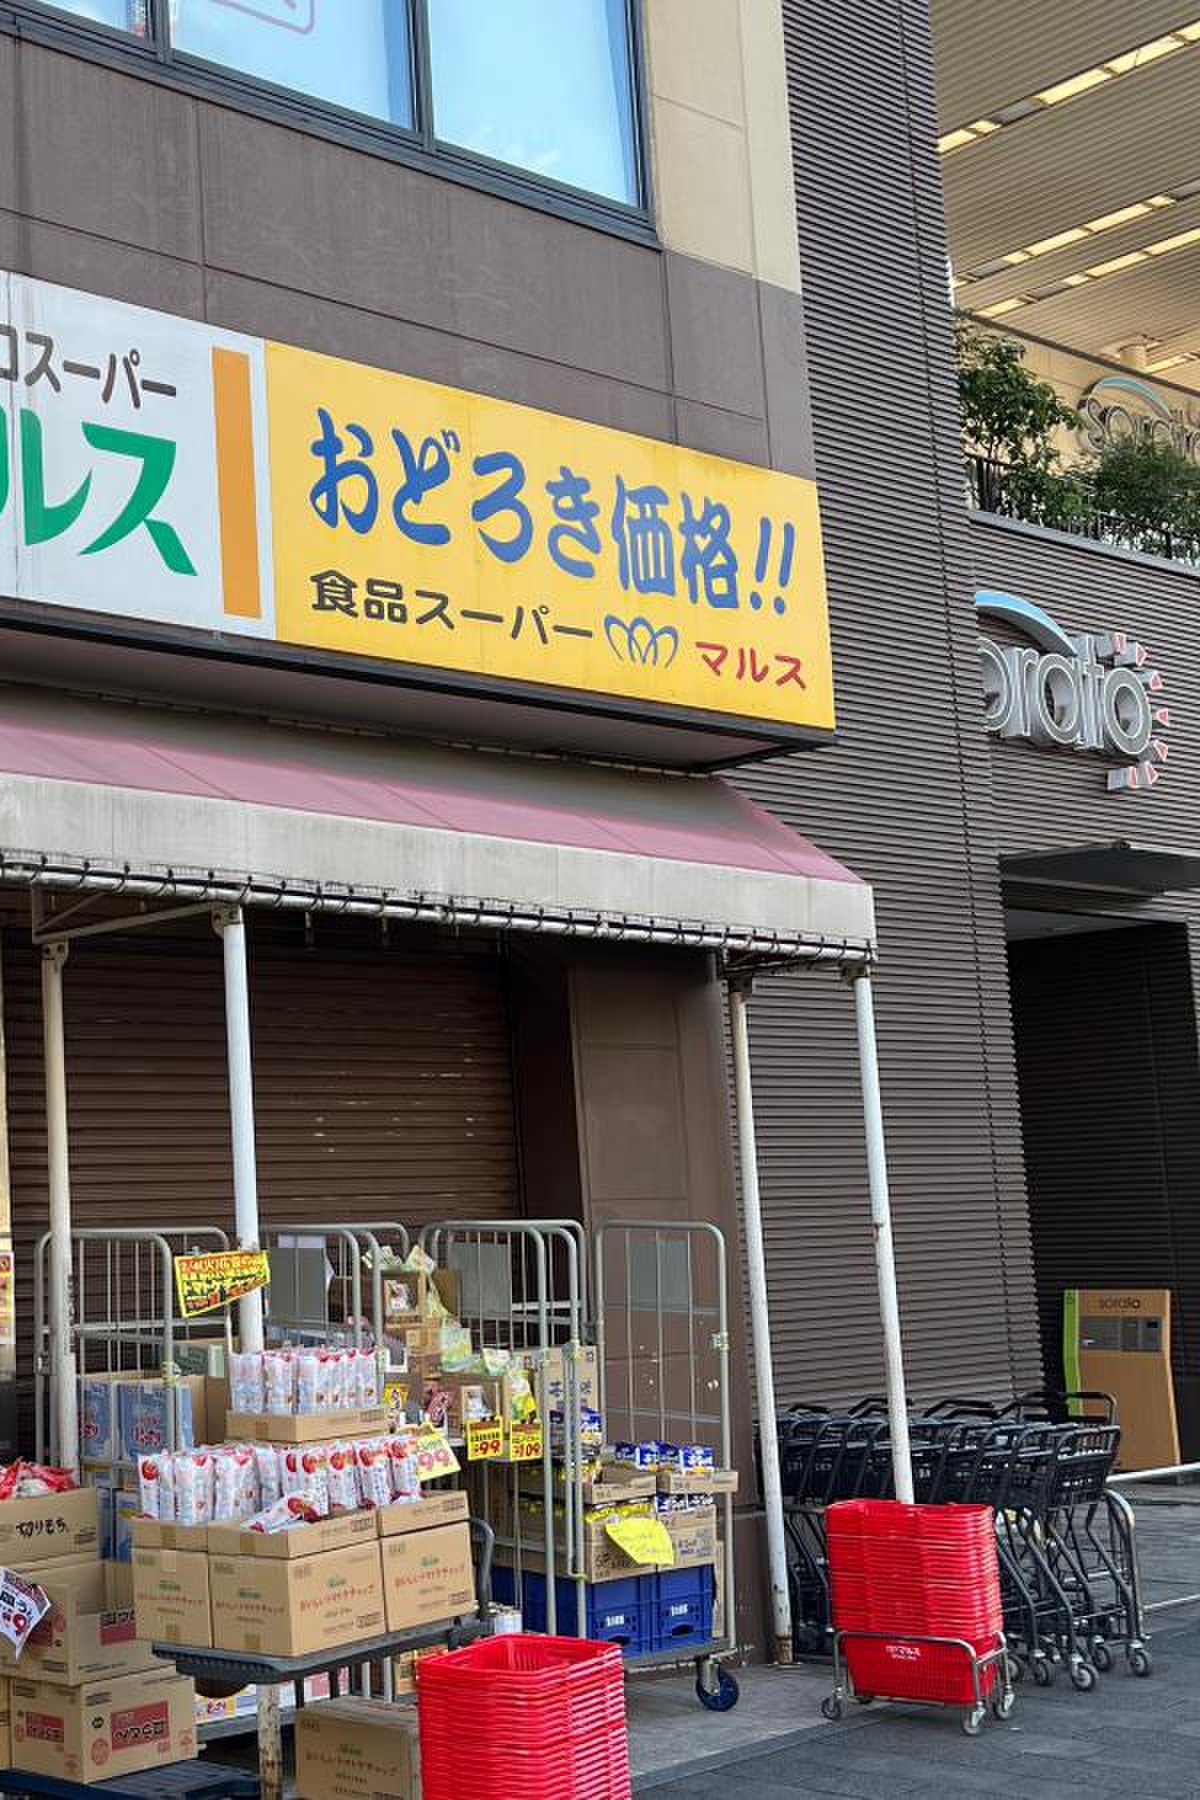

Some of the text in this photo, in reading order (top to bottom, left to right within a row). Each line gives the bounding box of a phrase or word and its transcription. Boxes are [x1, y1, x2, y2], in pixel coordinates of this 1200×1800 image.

[310, 407, 795, 615] おどろき価格!!
[310, 569, 593, 645] 食品スーパー
[695, 640, 807, 690] マルス
[480, 1440, 501, 1455] 99
